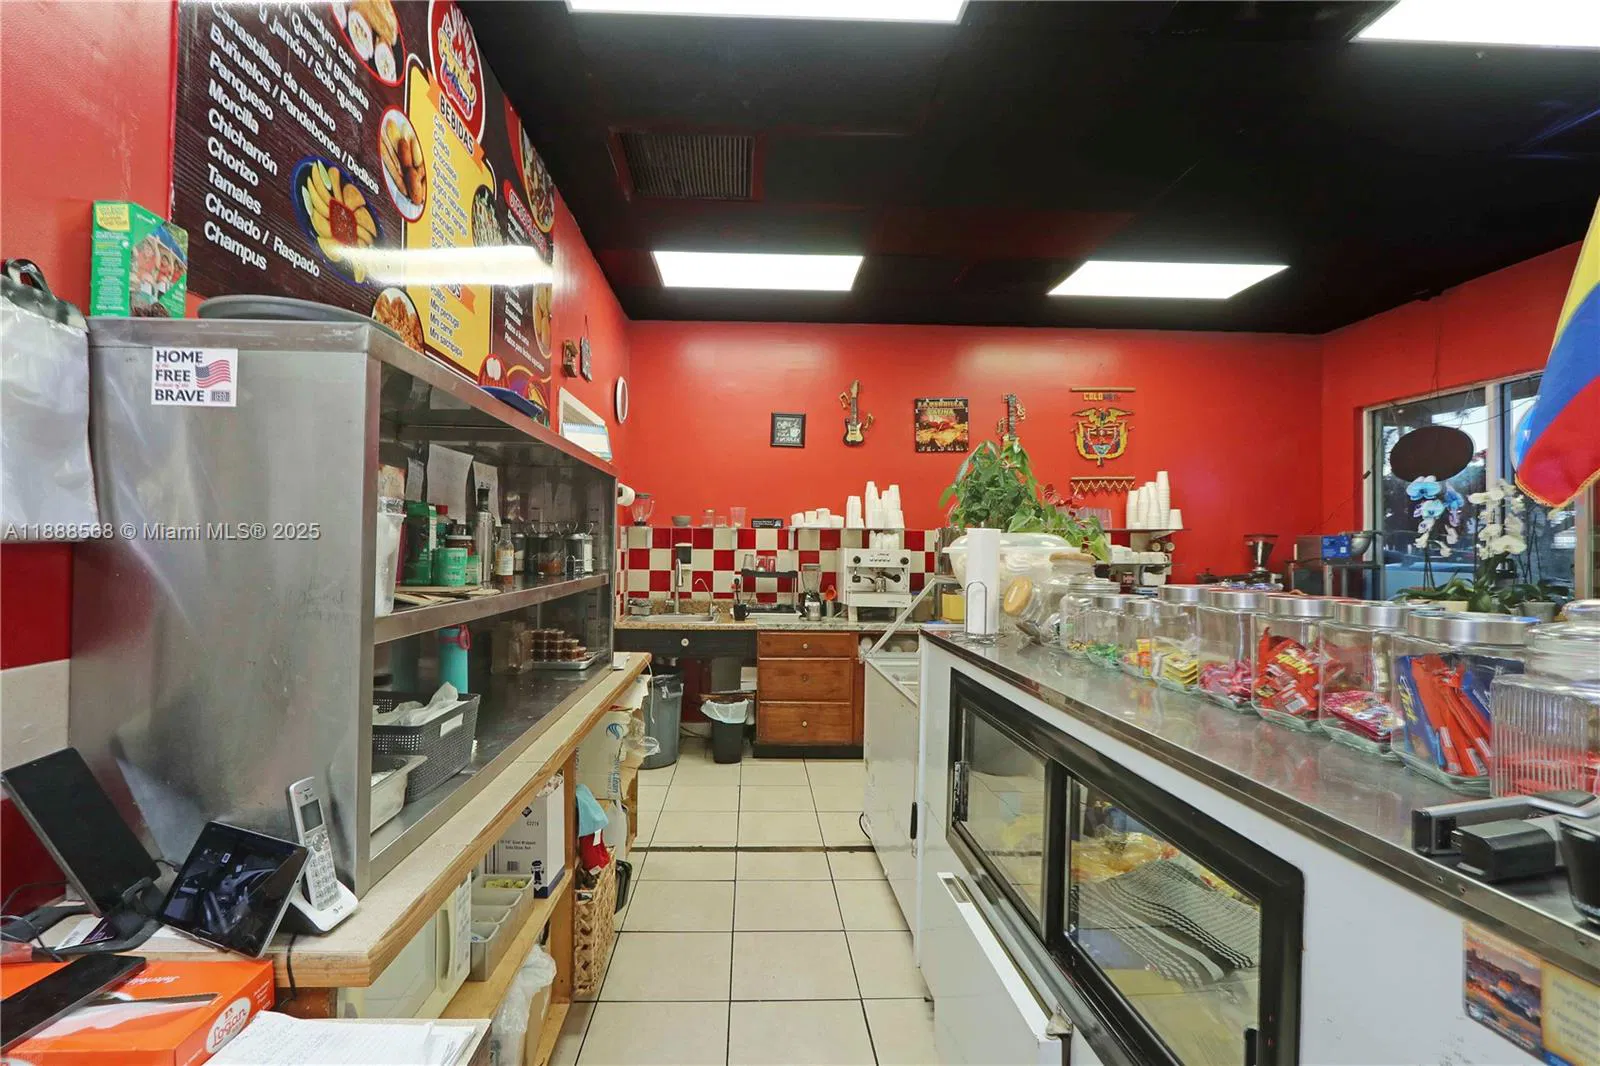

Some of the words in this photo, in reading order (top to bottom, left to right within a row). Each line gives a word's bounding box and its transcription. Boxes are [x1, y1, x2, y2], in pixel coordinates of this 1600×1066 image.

[209, 50, 273, 120] Panqueso
[211, 3, 281, 78] Canastillas
[283, 72, 298, 93] de
[299, 88, 336, 131] maduro
[291, 12, 324, 58] Queso
[333, 63, 369, 110] guayaba
[208, 79, 259, 135] Morcilla
[210, 22, 270, 92] Buñuelos
[279, 92, 340, 159] Pandebonos
[313, 61, 336, 93] Solo
[336, 88, 362, 123] queso
[208, 108, 277, 176] Chicharrón
[440, 95, 474, 155] BEBIDAS
[207, 136, 259, 186] Chorizo
[207, 163, 261, 215] Tamales
[204, 221, 267, 270] Champus
[205, 192, 260, 241] Cholado
[273, 236, 320, 277] Raspado
[155, 369, 191, 382] FREE
[156, 350, 203, 363] HOME
[154, 389, 204, 402] BRAVE
[212, 1008, 246, 1048] Logan
